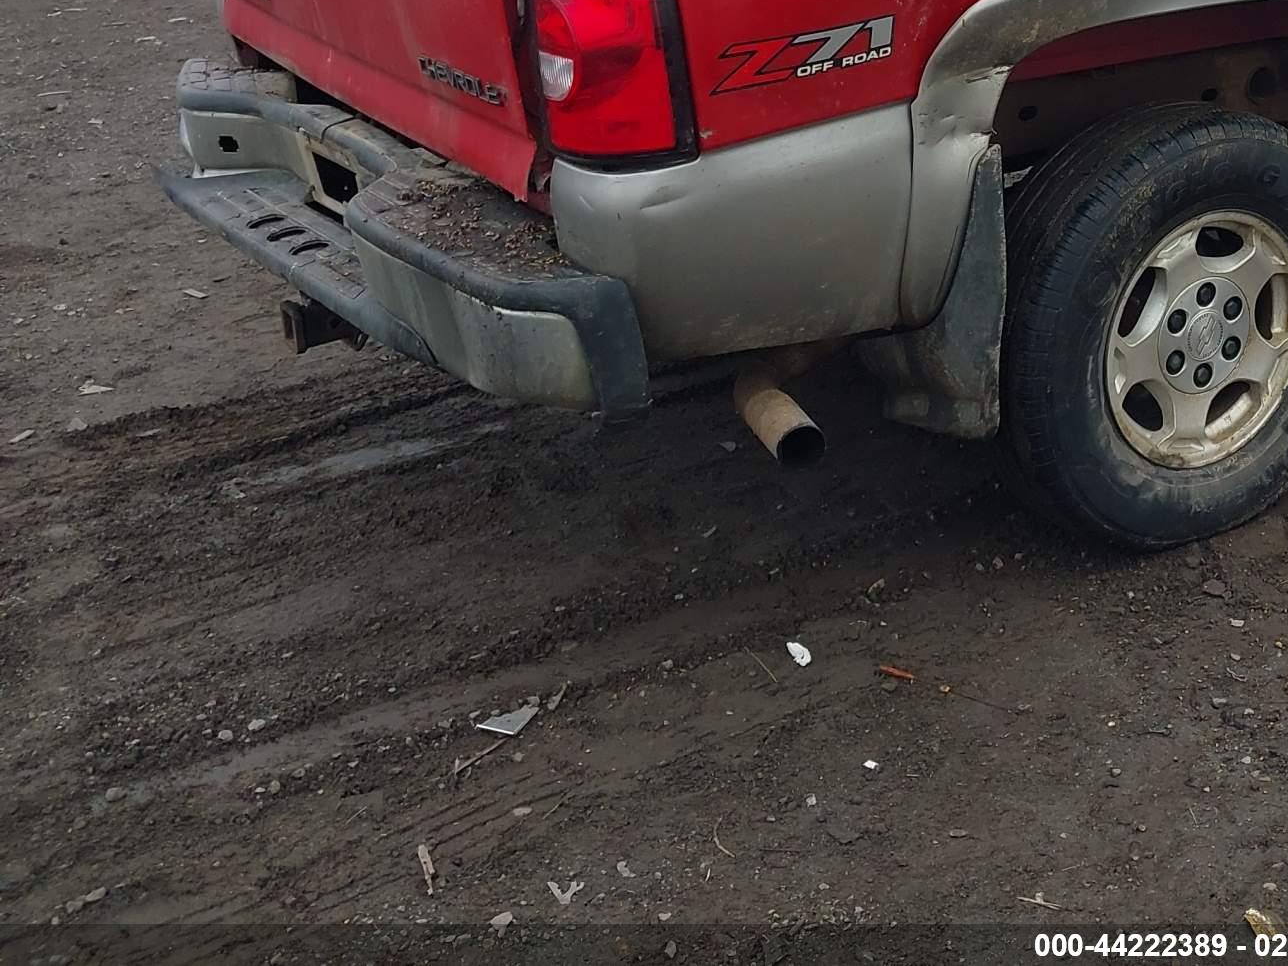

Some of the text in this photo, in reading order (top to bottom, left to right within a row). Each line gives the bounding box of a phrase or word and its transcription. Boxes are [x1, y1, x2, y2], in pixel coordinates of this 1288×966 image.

[709, 14, 895, 96] Z71
[796, 46, 893, 78] OFF ROAD
